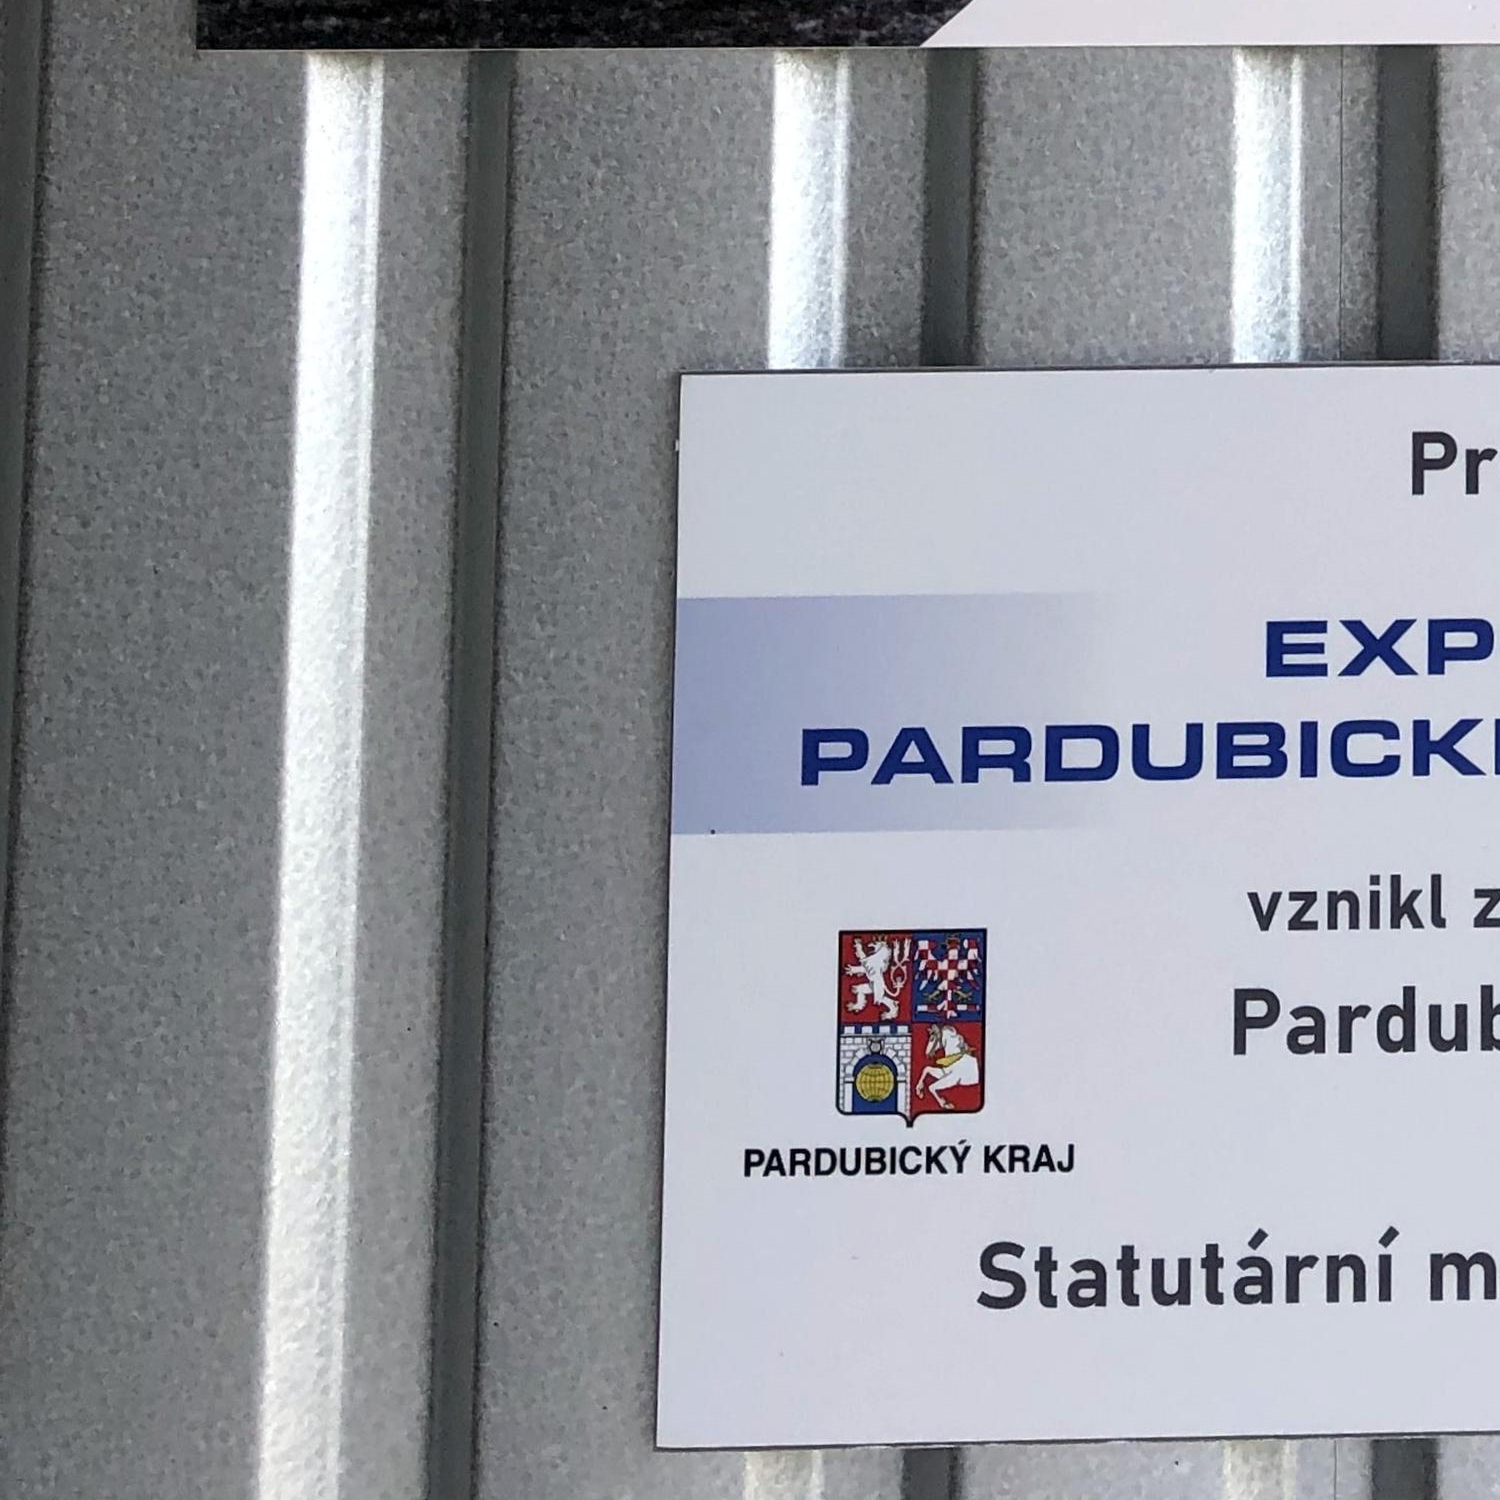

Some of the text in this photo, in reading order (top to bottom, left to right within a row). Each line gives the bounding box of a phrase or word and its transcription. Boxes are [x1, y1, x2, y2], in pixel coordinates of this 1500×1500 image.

[1246, 873, 1447, 932] vznikl
[743, 1139, 1075, 1178] PARDUBICKÝ KRAJ
[976, 1225, 1400, 1310] Statutární
